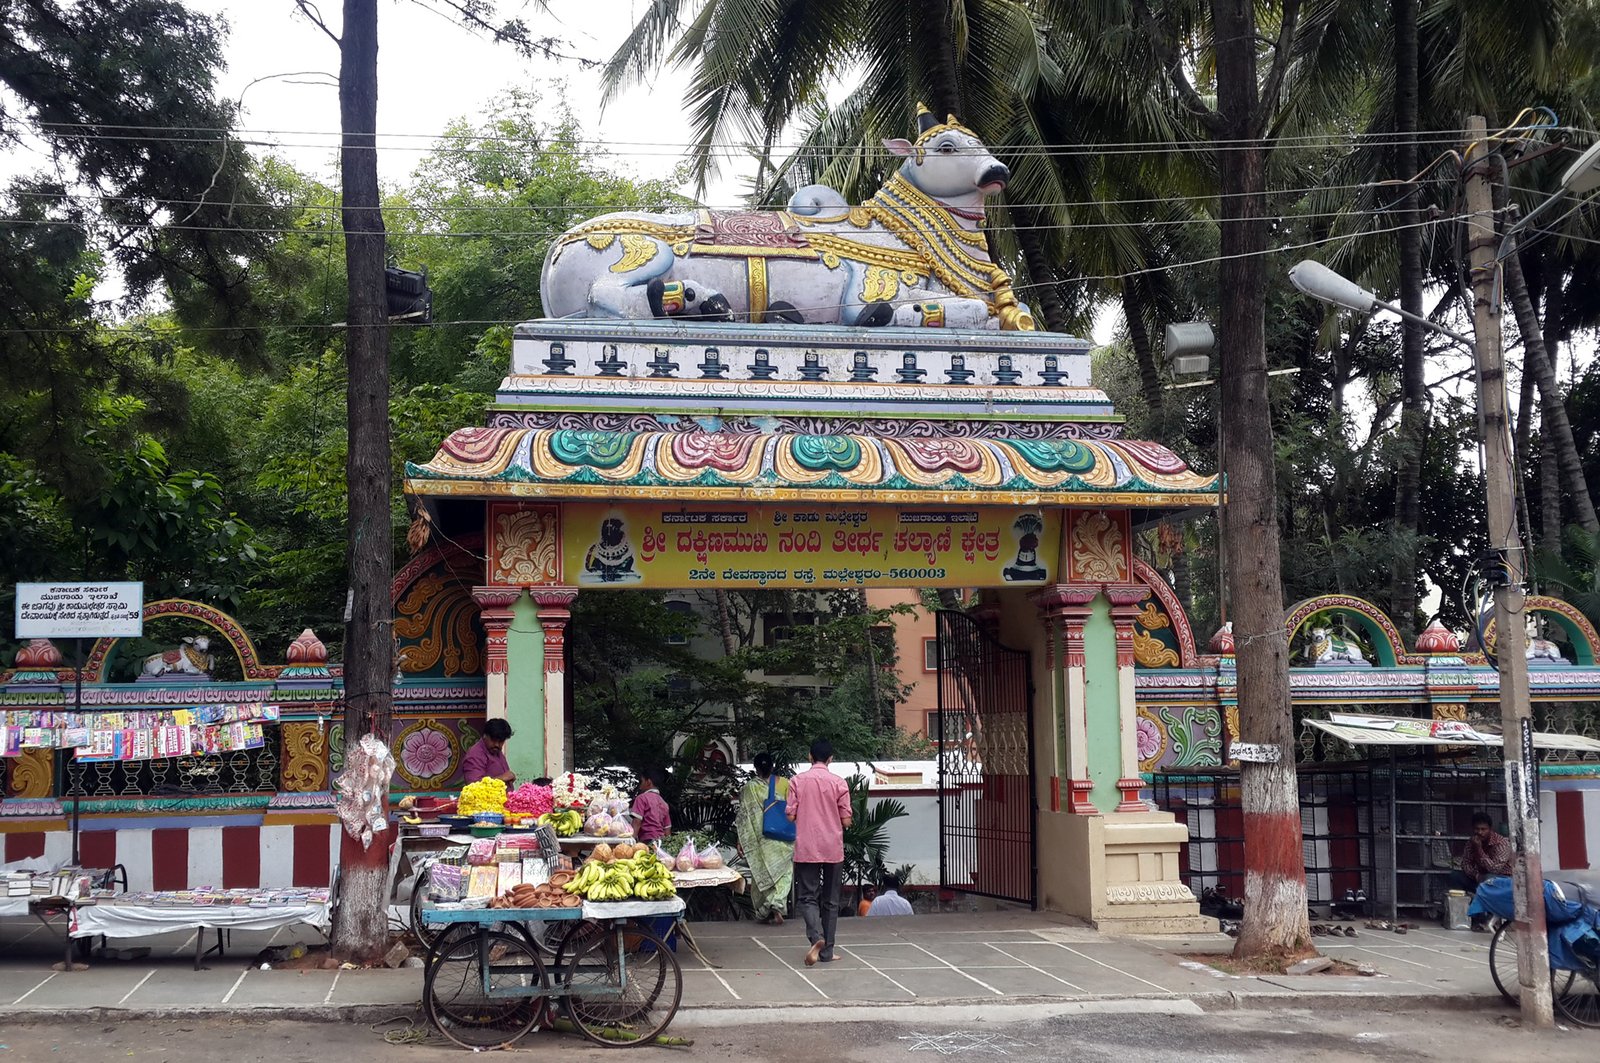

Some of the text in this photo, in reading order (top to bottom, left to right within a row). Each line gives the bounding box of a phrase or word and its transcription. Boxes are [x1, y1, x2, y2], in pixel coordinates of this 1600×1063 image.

[663, 513, 747, 522] ಕರ್ನಾಟಕ ಸರ್ಕಾರ
[773, 510, 868, 528] ಶ್ರೀ ಕಾಡು ಮಲ್ಲೇಶ್ವರ
[900, 512, 946, 522] ಮುಜರಾಯಿ
[641, 525, 1000, 565] ಶ್ರೀ ದಕ್ಷಿಣಮುಖ ನಂದಿ ತೀರ್ಥ ಕಲ್ಯಾಣಿ ಕ್ಷೇತ್ರ
[689, 568, 716, 580] 2ನೇ
[722, 568, 787, 585] ದೇವಸ್ಥಾನದ
[49, 586, 80, 594] ಕರ್ನಾಟಕ
[88, 592, 119, 601] ಇಲಾಖೆ
[57, 602, 65, 612] ಶ್ರೀ
